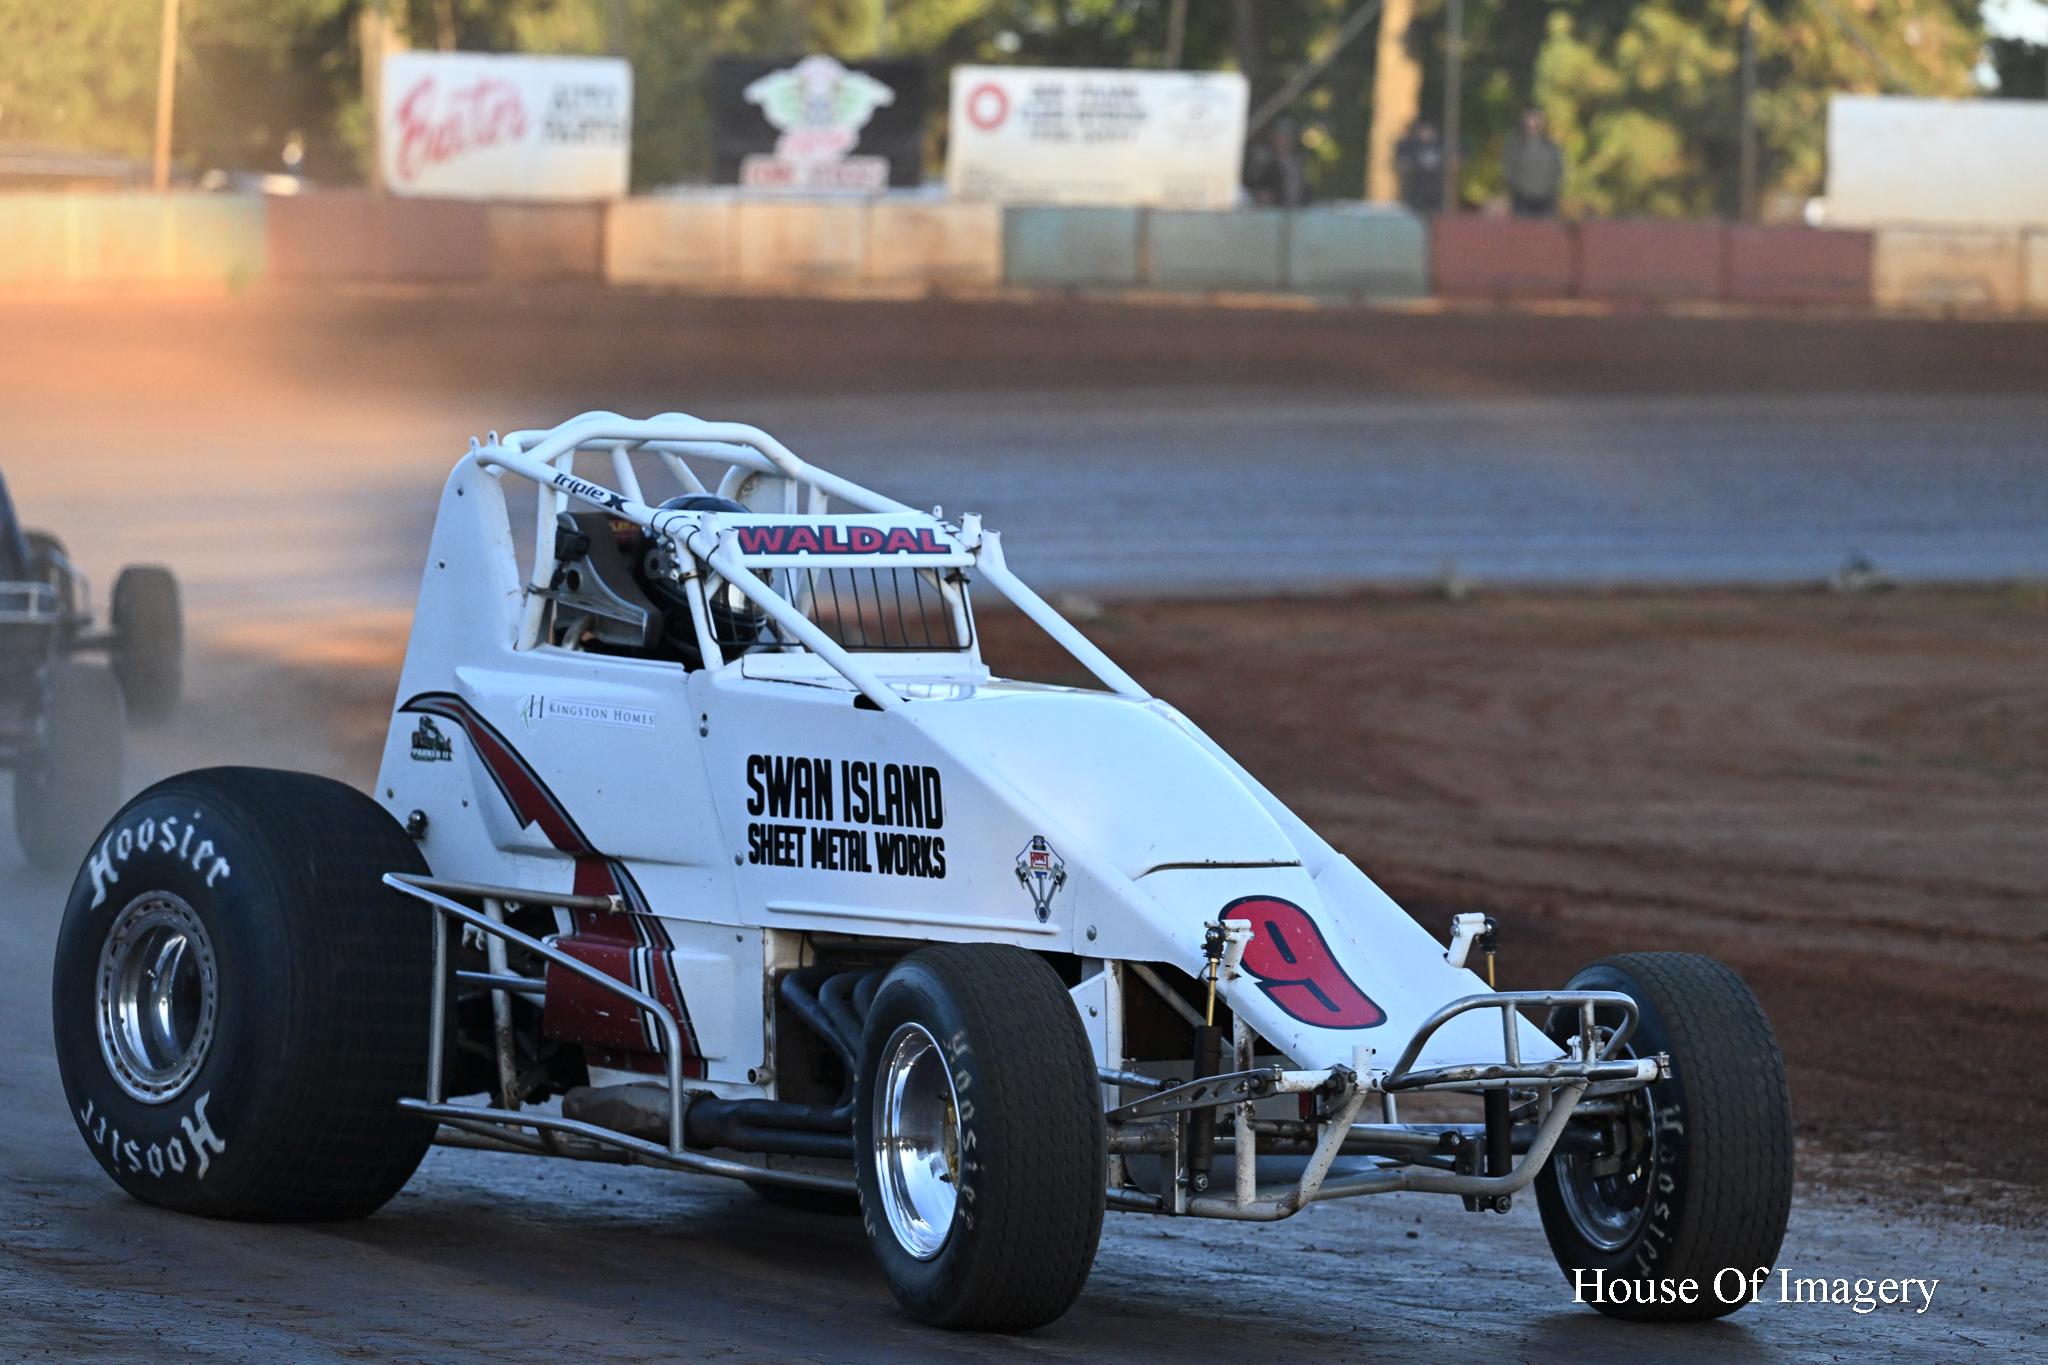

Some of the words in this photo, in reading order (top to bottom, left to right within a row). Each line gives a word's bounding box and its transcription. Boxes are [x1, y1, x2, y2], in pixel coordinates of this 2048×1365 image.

[553, 472, 605, 501] Triple
[732, 525, 952, 556] WALDAL
[549, 701, 608, 719] KINGSTON
[613, 709, 655, 726] HOMES
[746, 754, 834, 822] SWAN
[841, 760, 944, 830] ISLAND
[88, 811, 231, 911] Hoosier
[747, 822, 807, 868] SHEET
[811, 826, 873, 874] METAL
[874, 831, 946, 879] WORKS
[1218, 894, 1388, 1031] 9
[80, 1089, 226, 1181] Hoosier
